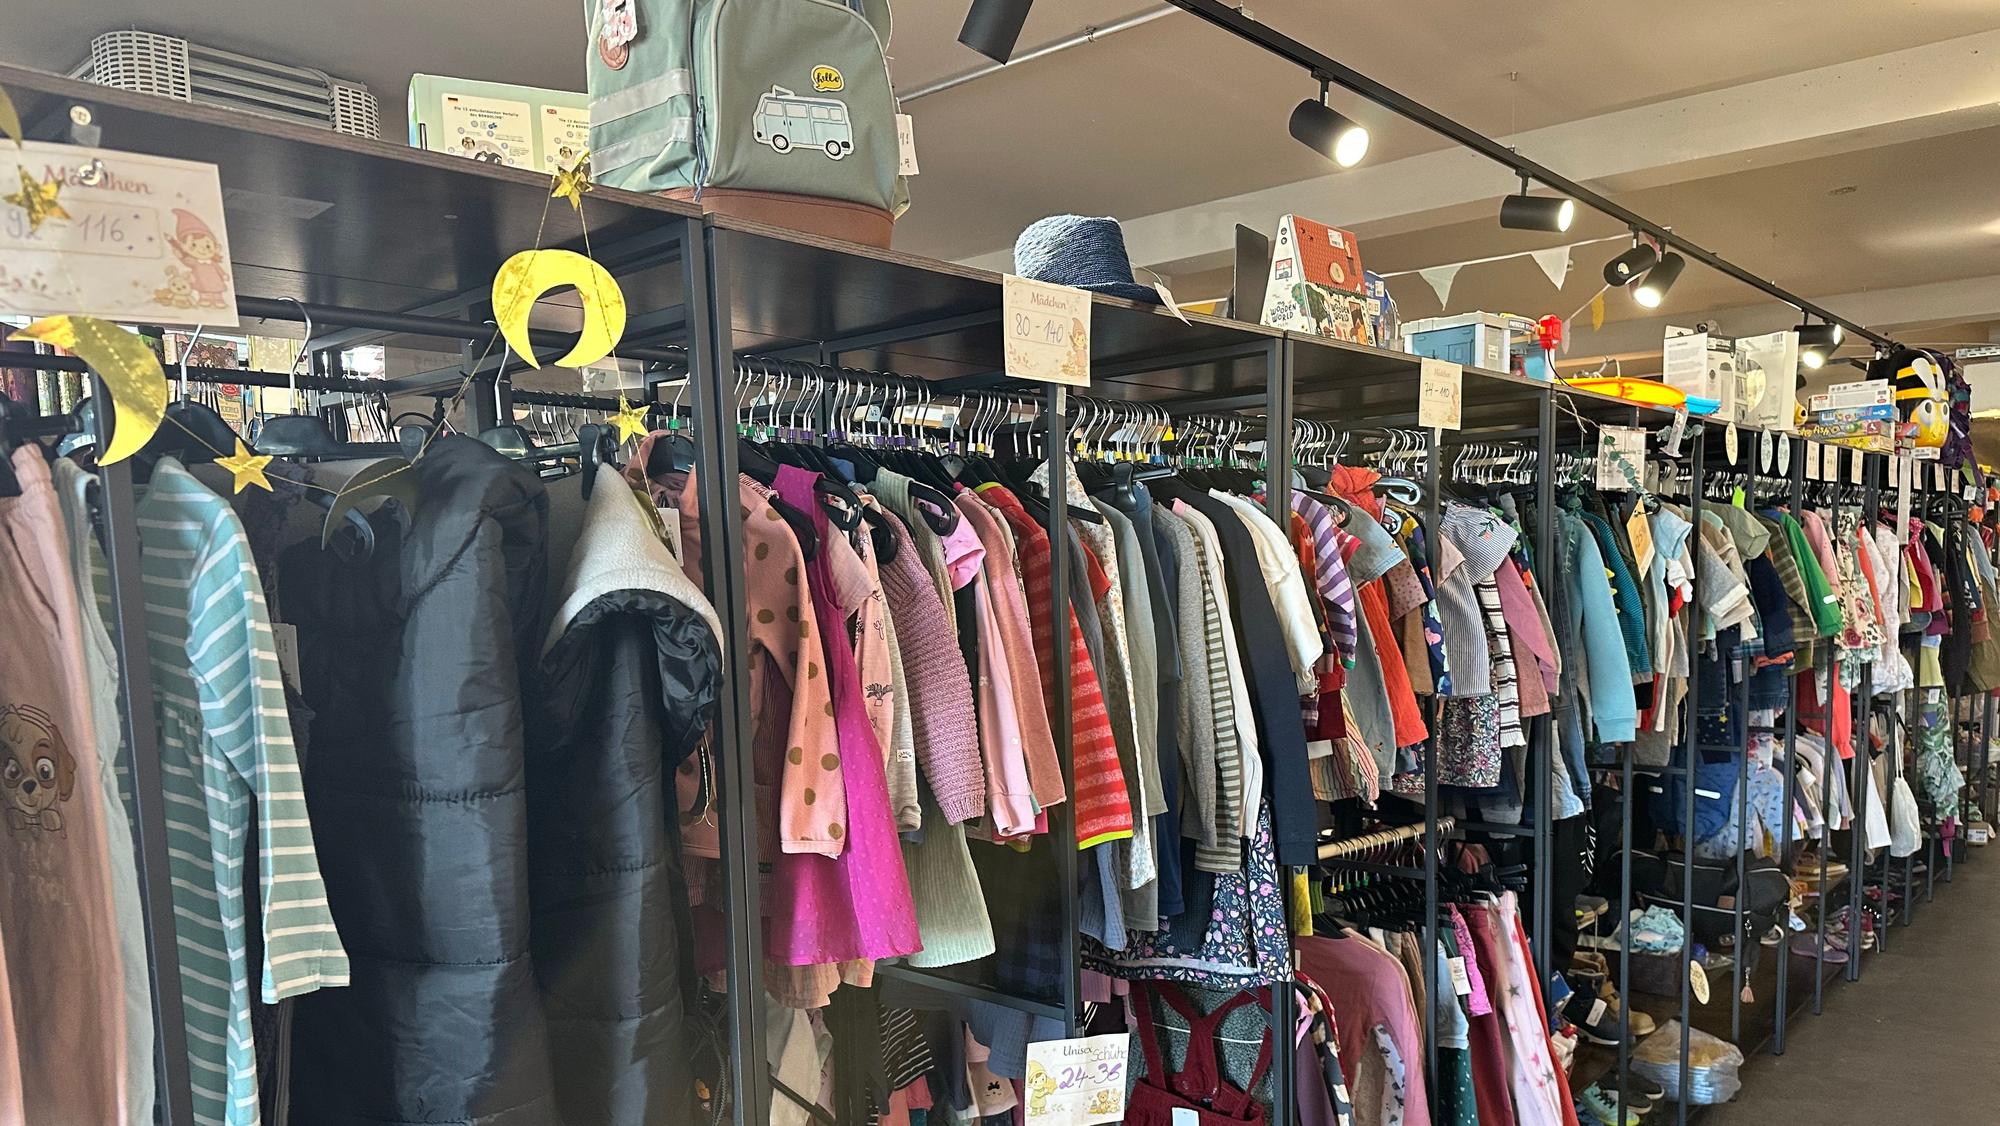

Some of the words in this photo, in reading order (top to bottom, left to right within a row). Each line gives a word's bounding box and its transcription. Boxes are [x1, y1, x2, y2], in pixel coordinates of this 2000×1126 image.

[77, 212, 125, 243] 116
[1030, 291, 1067, 310] Mädchen
[1269, 302, 1297, 316] WOODEN
[1271, 310, 1294, 323] WORLD
[1016, 312, 1031, 337] 80
[1063, 1045, 1092, 1057] Unisex
